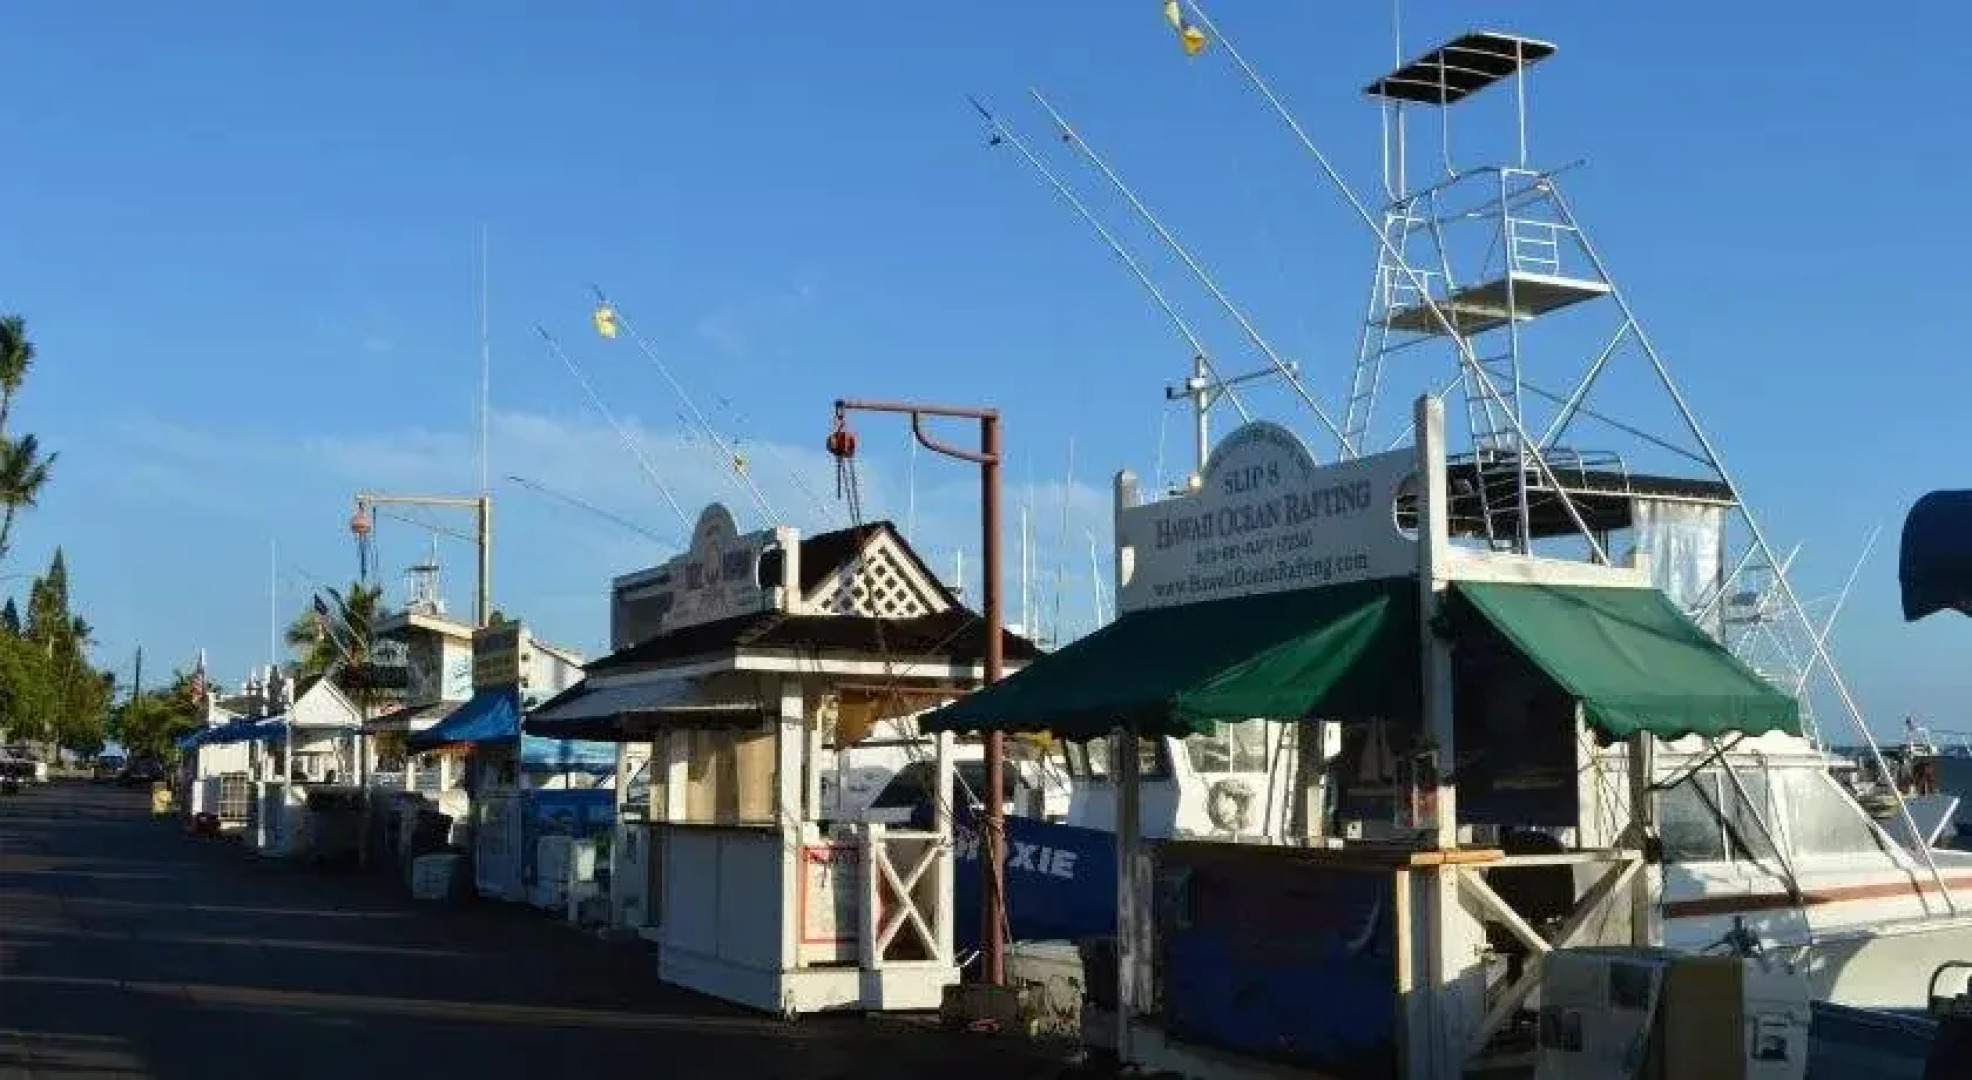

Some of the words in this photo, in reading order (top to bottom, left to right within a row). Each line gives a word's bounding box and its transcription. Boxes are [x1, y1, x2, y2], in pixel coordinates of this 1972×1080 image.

[1224, 465, 1264, 496] SLIP
[1267, 460, 1280, 487] 8
[1155, 511, 1213, 549] HAWAII
[1217, 500, 1281, 537] OCEAN
[1284, 478, 1372, 525] RAFTING
